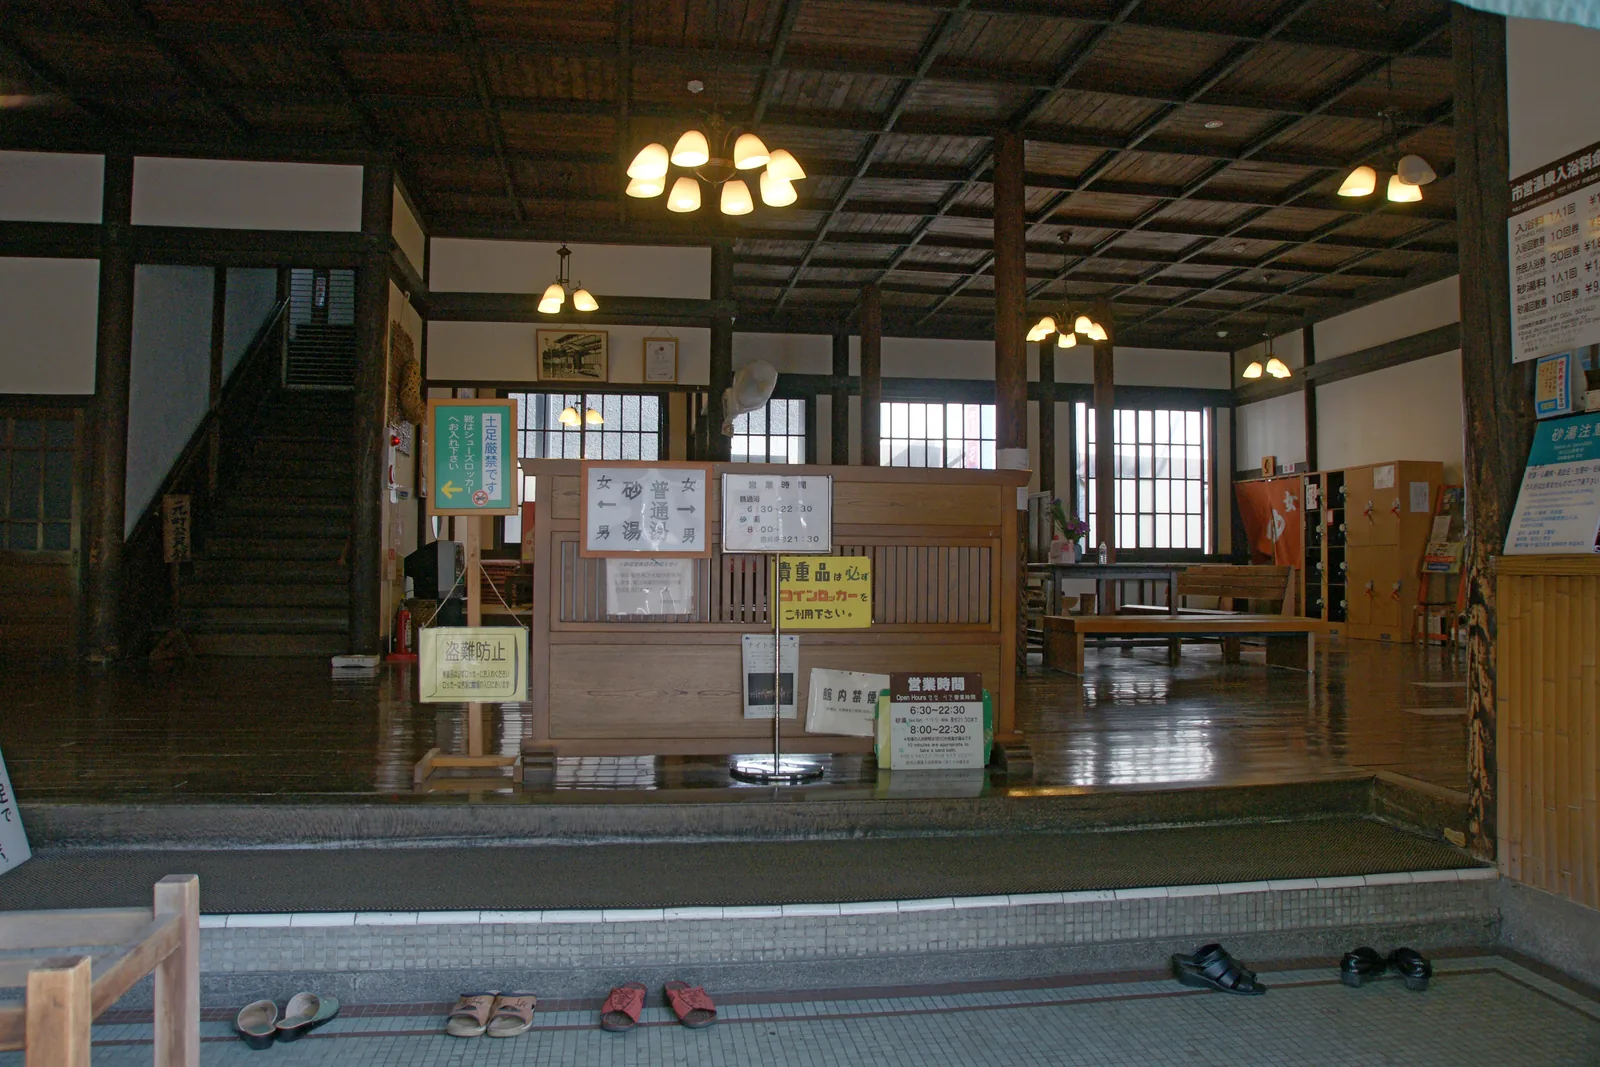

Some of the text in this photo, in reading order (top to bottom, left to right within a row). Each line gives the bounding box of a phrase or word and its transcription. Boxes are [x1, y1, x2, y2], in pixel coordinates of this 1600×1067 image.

[448, 416, 460, 470] へお入れ下さい
[463, 415, 475, 494] 靴はシューズロッカー
[484, 415, 498, 495] 土足厳禁です
[596, 475, 612, 490] 女
[681, 477, 696, 492] 女
[748, 480, 807, 490] 営業時間
[1283, 490, 1298, 512] 女
[621, 481, 643, 541] 砂湯
[596, 525, 610, 540] 男
[681, 528, 696, 543] 男
[779, 561, 869, 582] 貴重品は必ず
[779, 589, 869, 602] コインロッカーを
[785, 608, 853, 621] ご利用下さい。
[445, 640, 506, 661] 盗難防止
[747, 641, 798, 650] ナイトクーズ
[907, 676, 965, 692] 営業時間
[822, 687, 878, 705] 館内禁煙
[896, 694, 910, 702] Open
[909, 705, 966, 715] 6:30~22:30
[909, 724, 966, 734] 8:00~22:30
